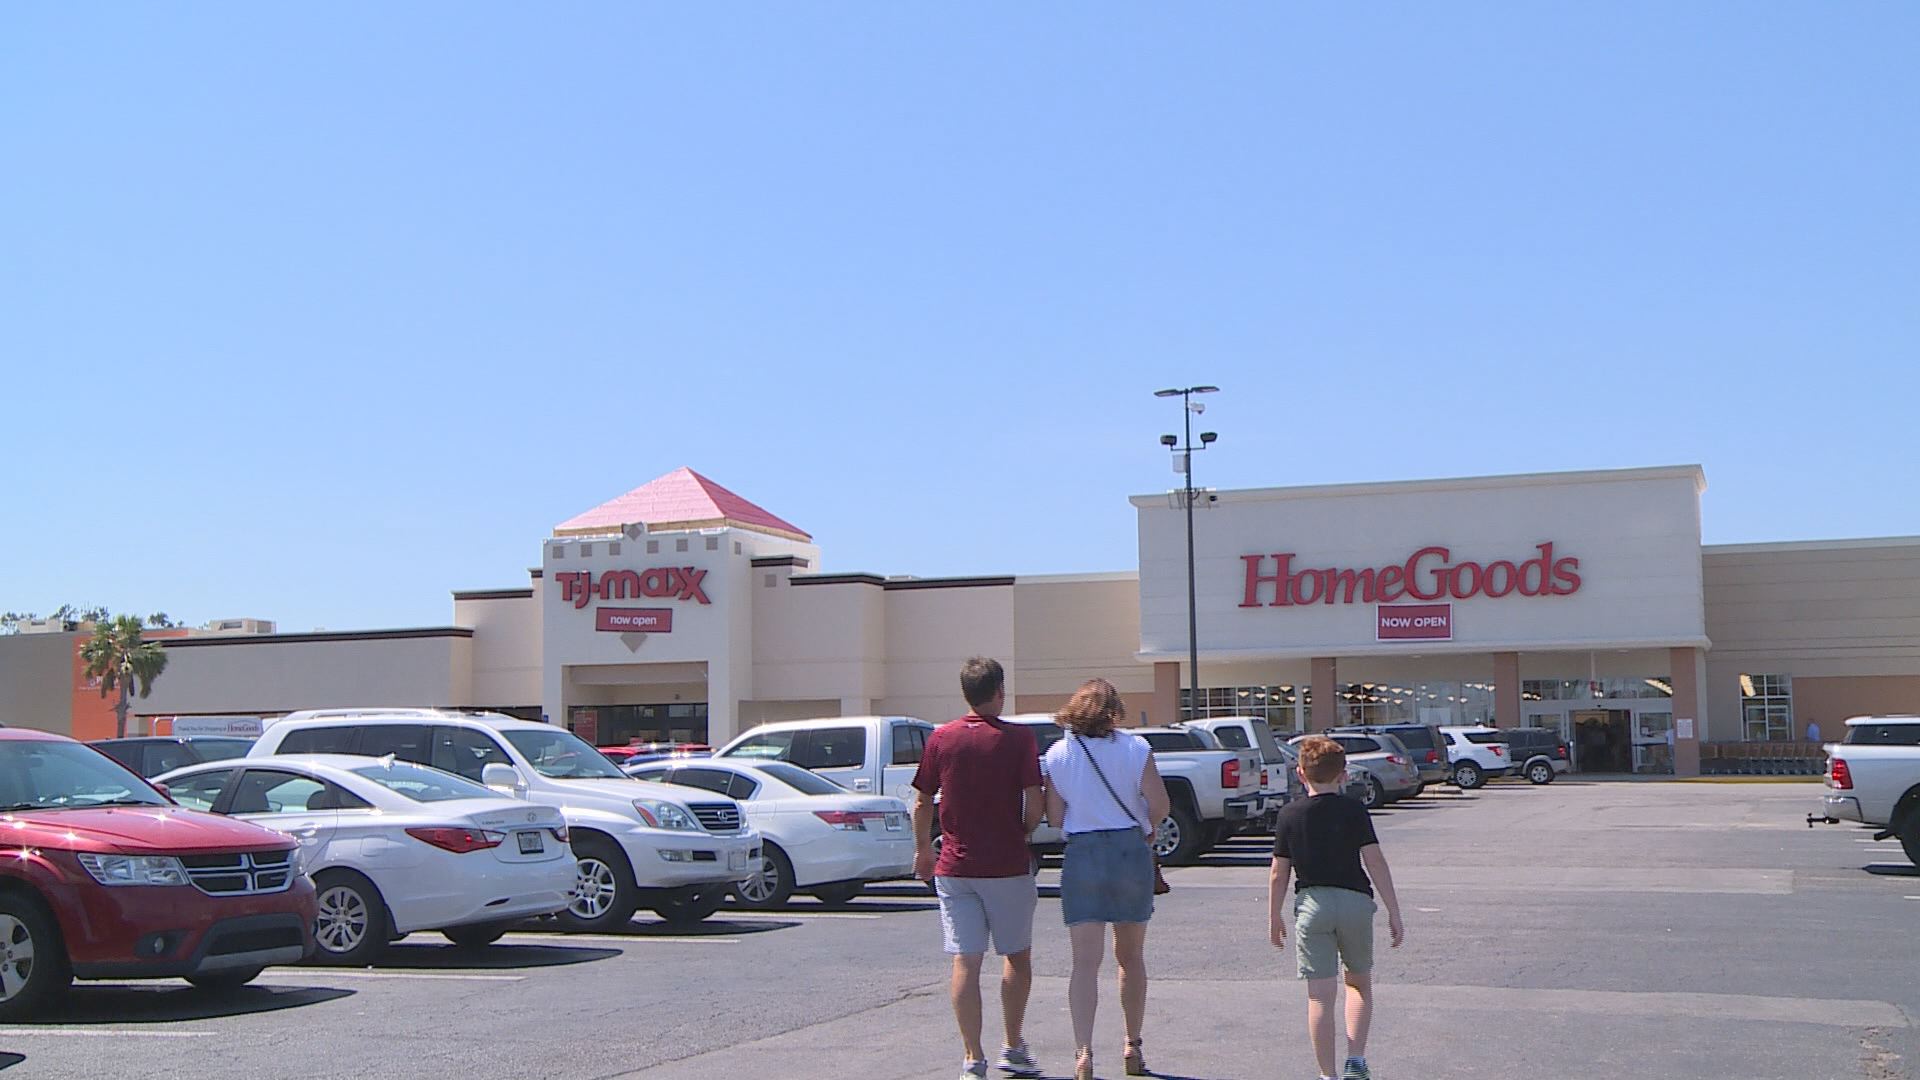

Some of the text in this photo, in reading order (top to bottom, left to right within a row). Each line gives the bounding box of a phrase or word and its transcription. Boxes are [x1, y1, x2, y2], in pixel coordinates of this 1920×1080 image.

[1238, 541, 1581, 608] HomeGoods
[610, 616, 656, 626] now open
[1381, 617, 1447, 628] NOW OPEN
